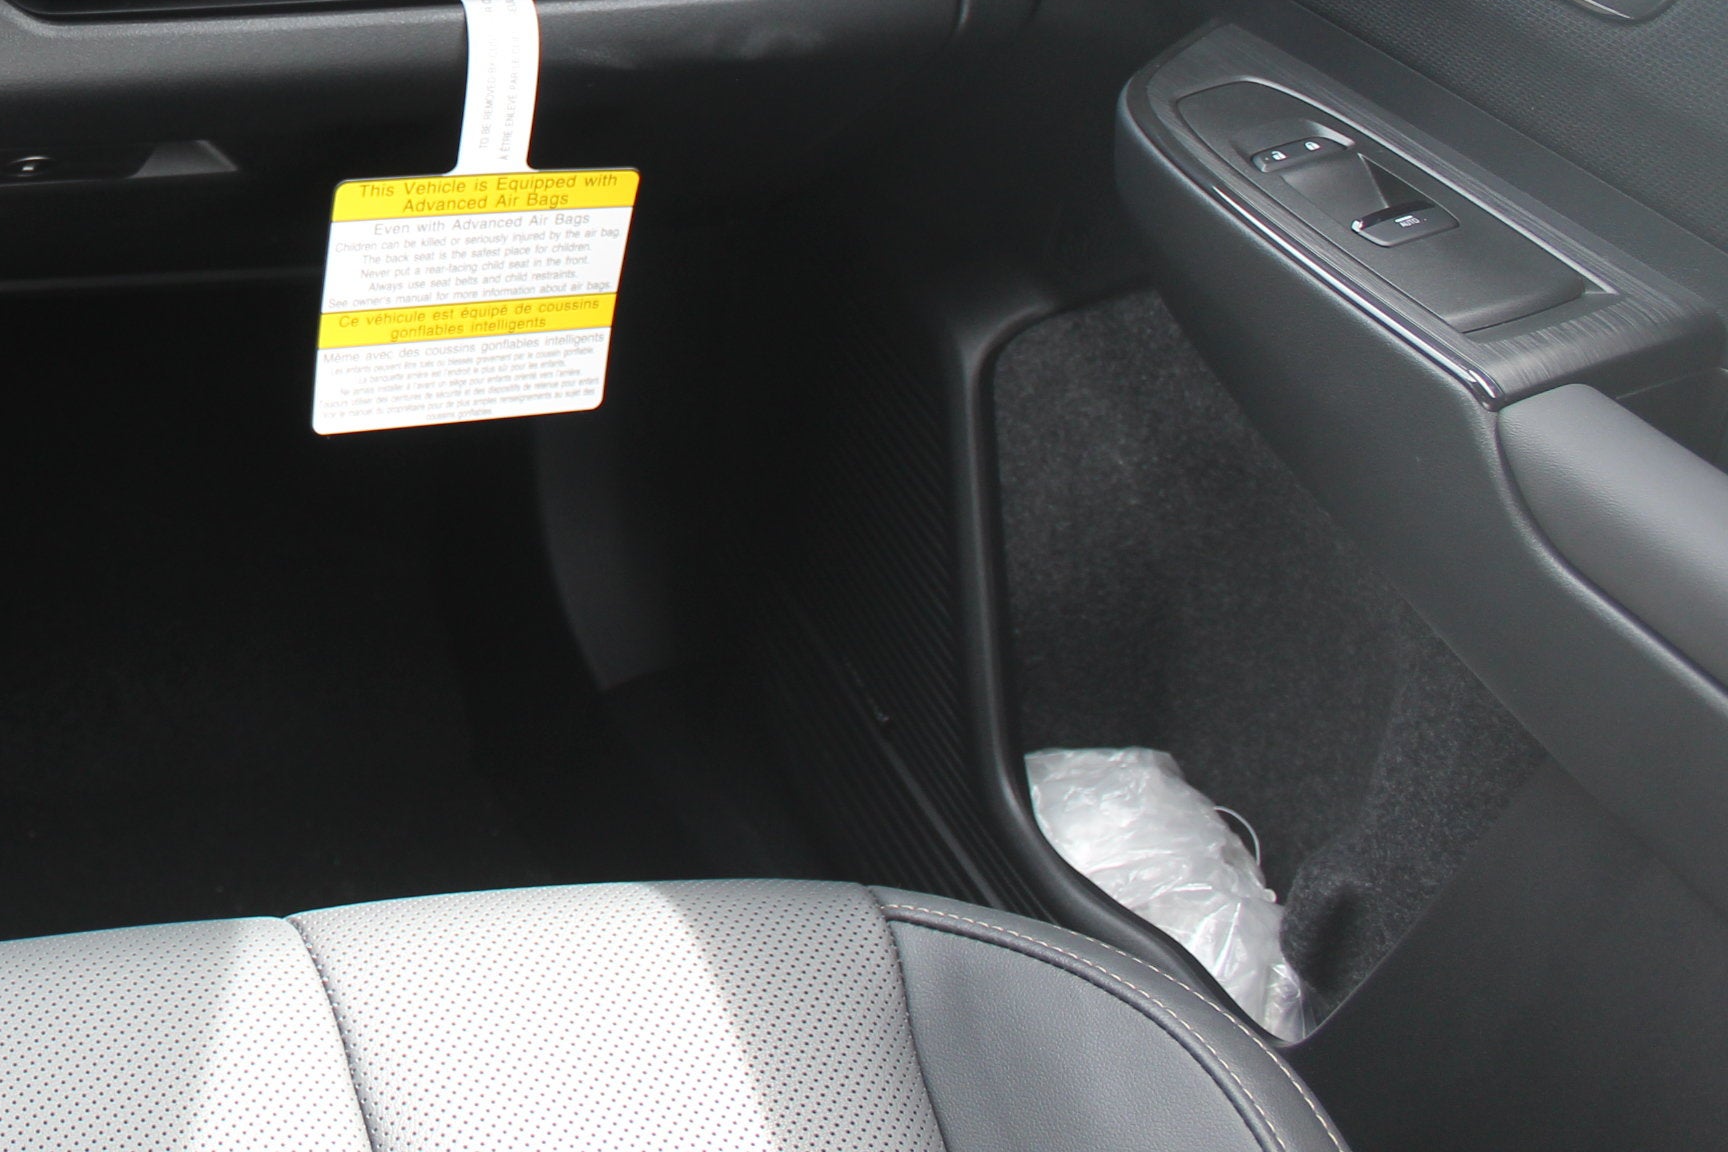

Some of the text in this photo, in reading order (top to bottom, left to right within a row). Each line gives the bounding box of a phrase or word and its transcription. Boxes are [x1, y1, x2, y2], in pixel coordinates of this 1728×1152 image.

[482, 77, 497, 120] REMOVED
[480, 123, 491, 134] BE
[361, 174, 618, 198] This Vehicle is Equipped with
[403, 190, 569, 213] Advanced Air Bags
[374, 213, 590, 236] Even with Advanced Air Bags
[335, 242, 377, 253] Children
[381, 241, 400, 250] can
[404, 238, 416, 248] be
[421, 236, 446, 247] killed
[451, 237, 461, 245] or
[465, 233, 508, 246] seriously
[513, 231, 545, 244] injured
[549, 230, 561, 241] by
[566, 229, 581, 239] the
[584, 227, 598, 237] air
[363, 254, 381, 265] The
[385, 252, 408, 263] back
[414, 251, 435, 262] seat
[439, 250, 447, 260] is
[451, 249, 467, 259] the
[471, 247, 500, 258] safest
[504, 245, 531, 258] place
[535, 243, 549, 254] for
[360, 267, 390, 278] Never
[394, 266, 410, 278] put
[482, 260, 504, 271] child
[509, 258, 530, 269] seat
[546, 256, 561, 265] the
[368, 281, 403, 293] Always
[408, 280, 426, 289] use
[430, 277, 451, 288] seat
[455, 275, 478, 286] belts
[482, 273, 501, 284] and
[505, 271, 527, 282] child
[328, 298, 348, 309] See
[396, 293, 432, 304] manual
[436, 291, 449, 301] for
[453, 290, 478, 299] more
[482, 286, 535, 298] information
[539, 283, 567, 294] about
[570, 282, 583, 292] air
[339, 298, 600, 328] Ce véhicule est équipé de coussins
[390, 317, 547, 342] gonflables intelligents
[323, 333, 604, 364] Même avec des coussins gonflables intelligents
